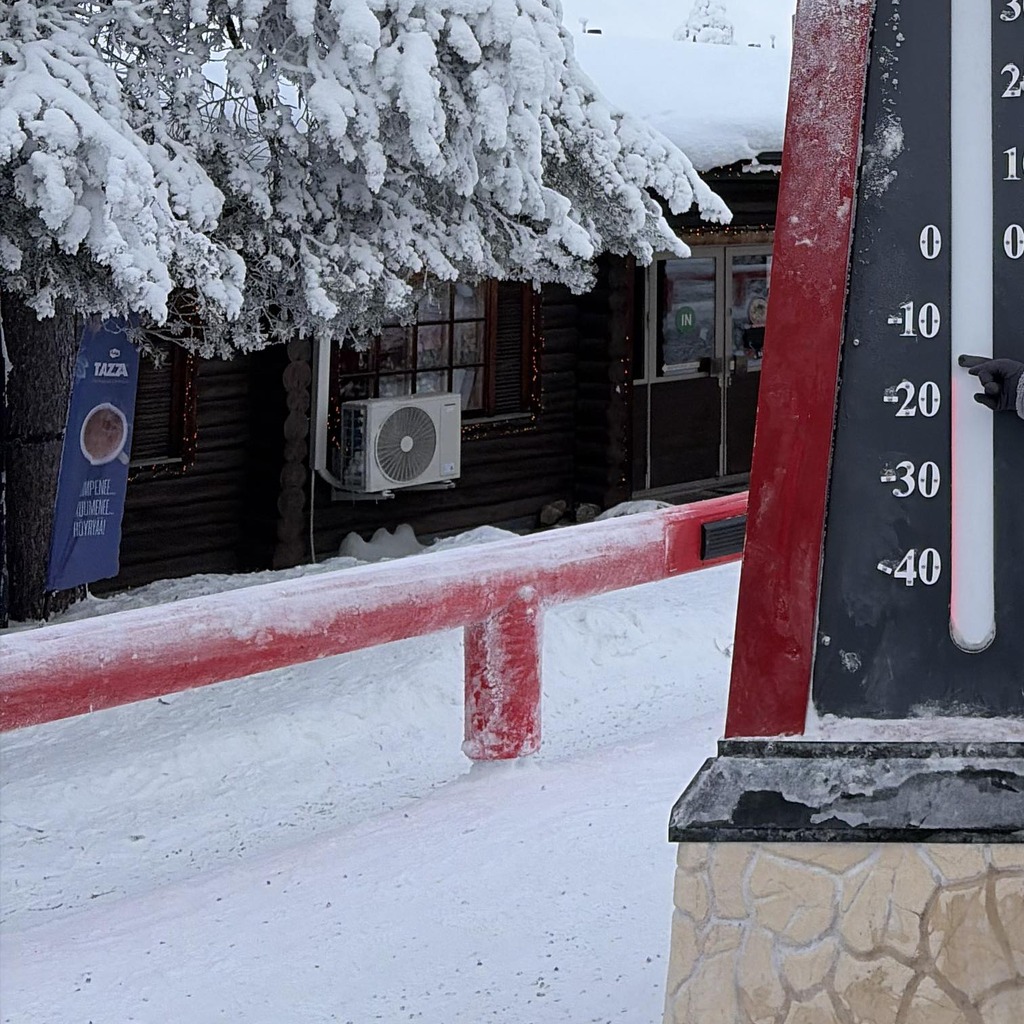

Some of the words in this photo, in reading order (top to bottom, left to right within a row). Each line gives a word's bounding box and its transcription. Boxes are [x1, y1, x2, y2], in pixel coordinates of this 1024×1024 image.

[919, 224, 942, 259] 0
[681, 314, 692, 326] IN
[887, 301, 941, 338] -10
[94, 362, 128, 377] TAZZA
[883, 380, 941, 417] -20
[880, 460, 941, 498] -30
[877, 547, 942, 587] -40
